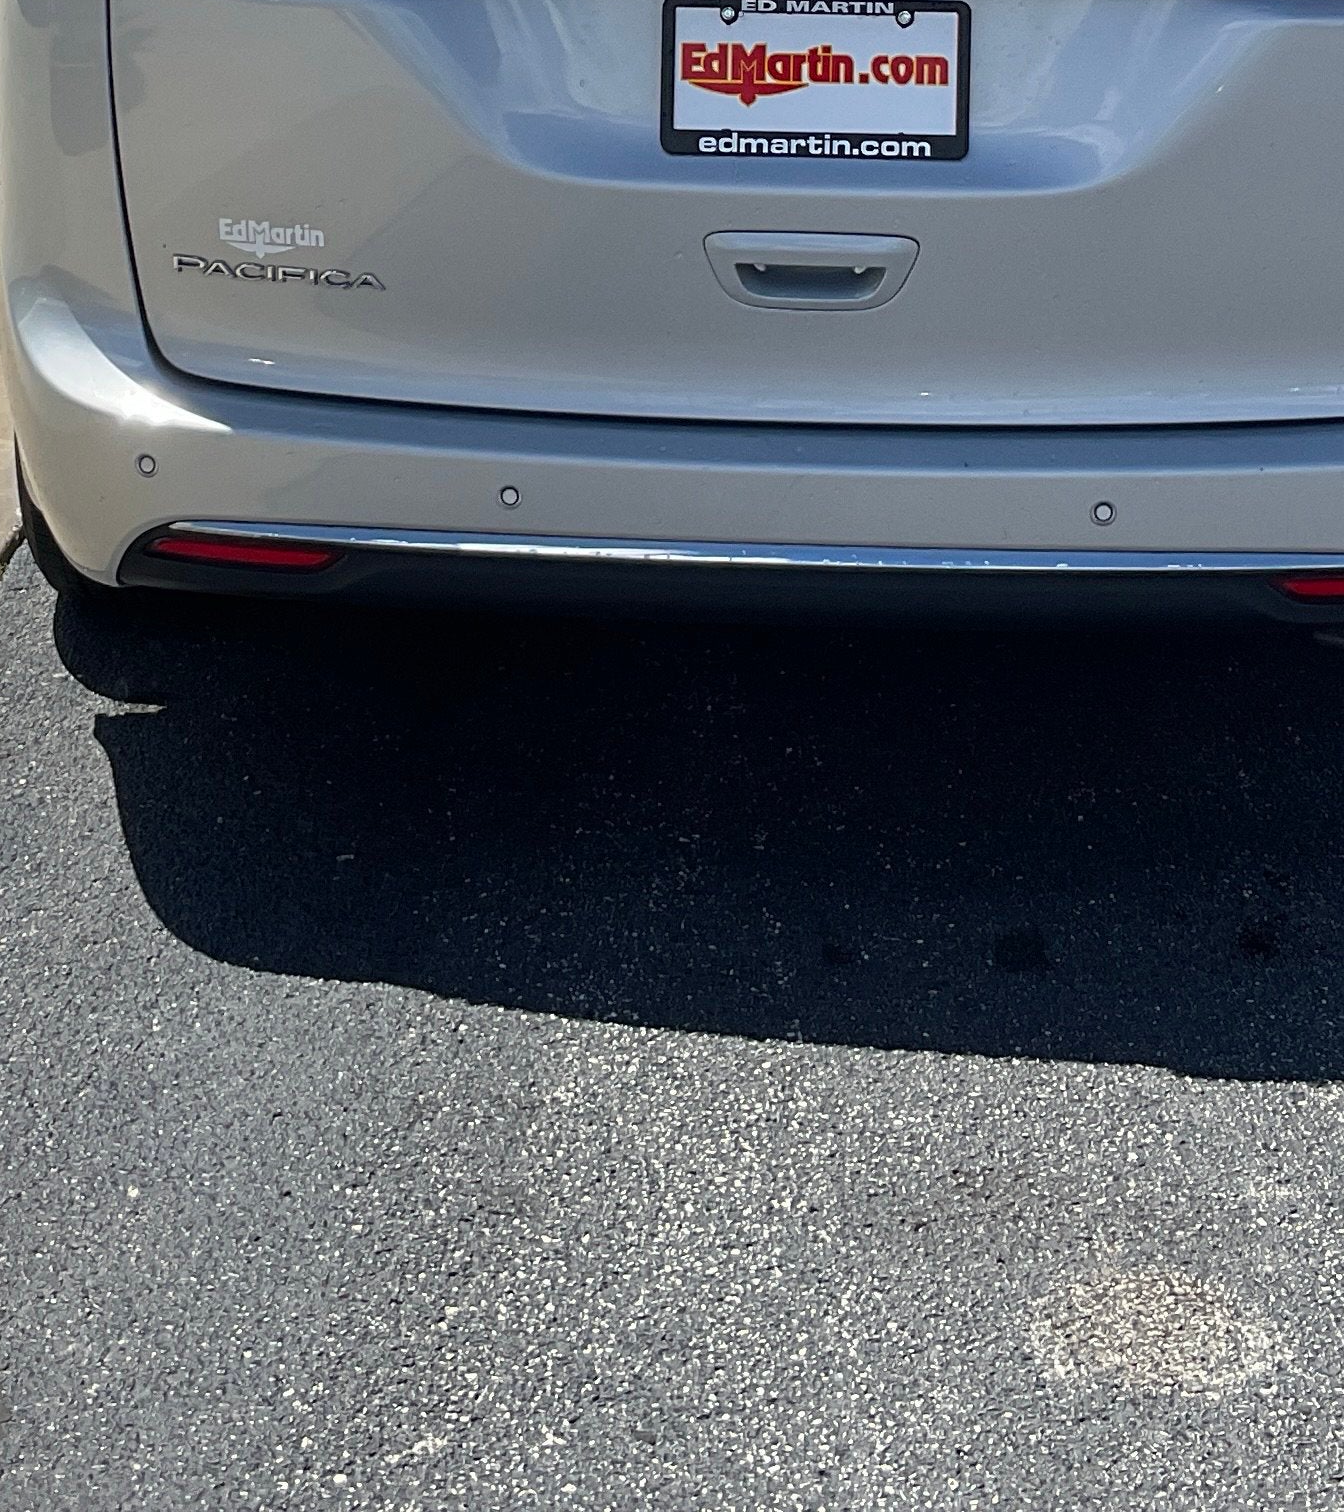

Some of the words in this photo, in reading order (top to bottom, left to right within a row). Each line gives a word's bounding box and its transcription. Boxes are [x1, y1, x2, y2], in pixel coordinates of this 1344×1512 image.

[741, 0, 777, 12] ED
[786, 1, 894, 14] MARTIN
[680, 42, 950, 87] EdMartin.com
[698, 132, 931, 157] edmartin.com
[218, 217, 325, 248] EdMartin
[172, 253, 387, 291] PACIFICA
